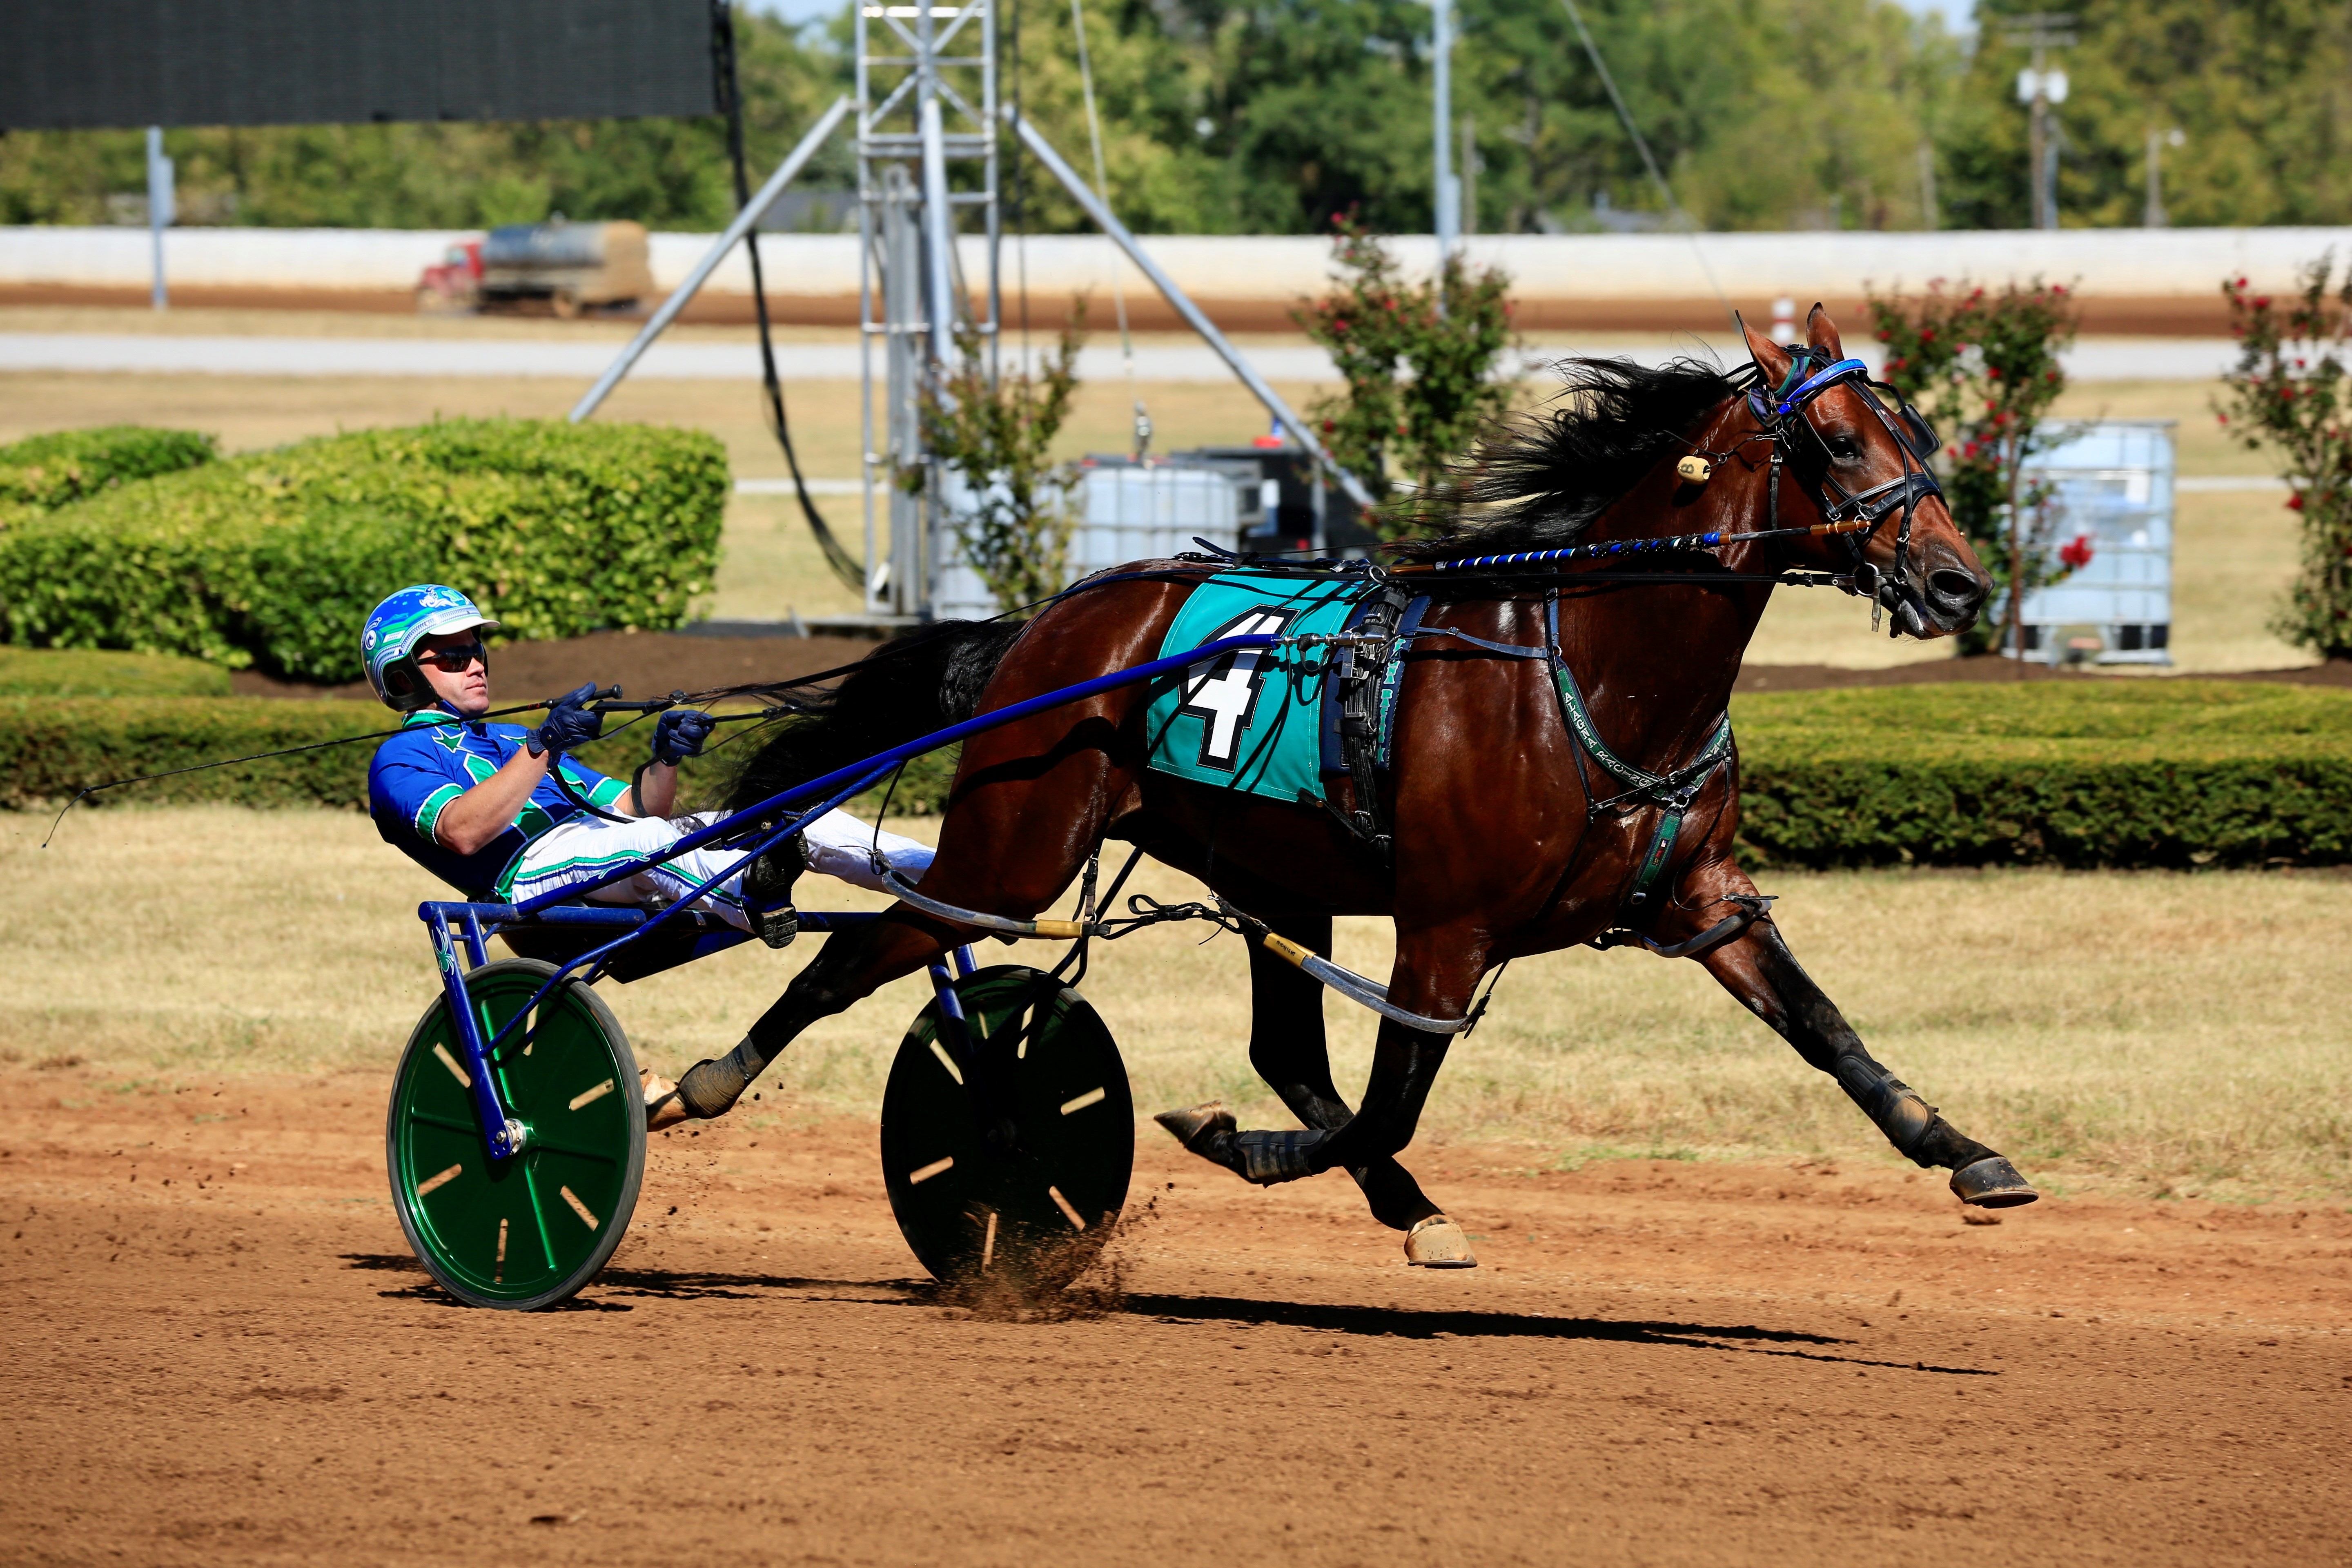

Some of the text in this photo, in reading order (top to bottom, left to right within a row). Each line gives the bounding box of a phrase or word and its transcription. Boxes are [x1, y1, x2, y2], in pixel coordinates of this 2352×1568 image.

[1827, 361, 1854, 376] ALAGNA
[1180, 605, 1298, 770] 4
[1378, 689, 1393, 743] RACING
[1565, 692, 1650, 787] ALAGNA RACING
